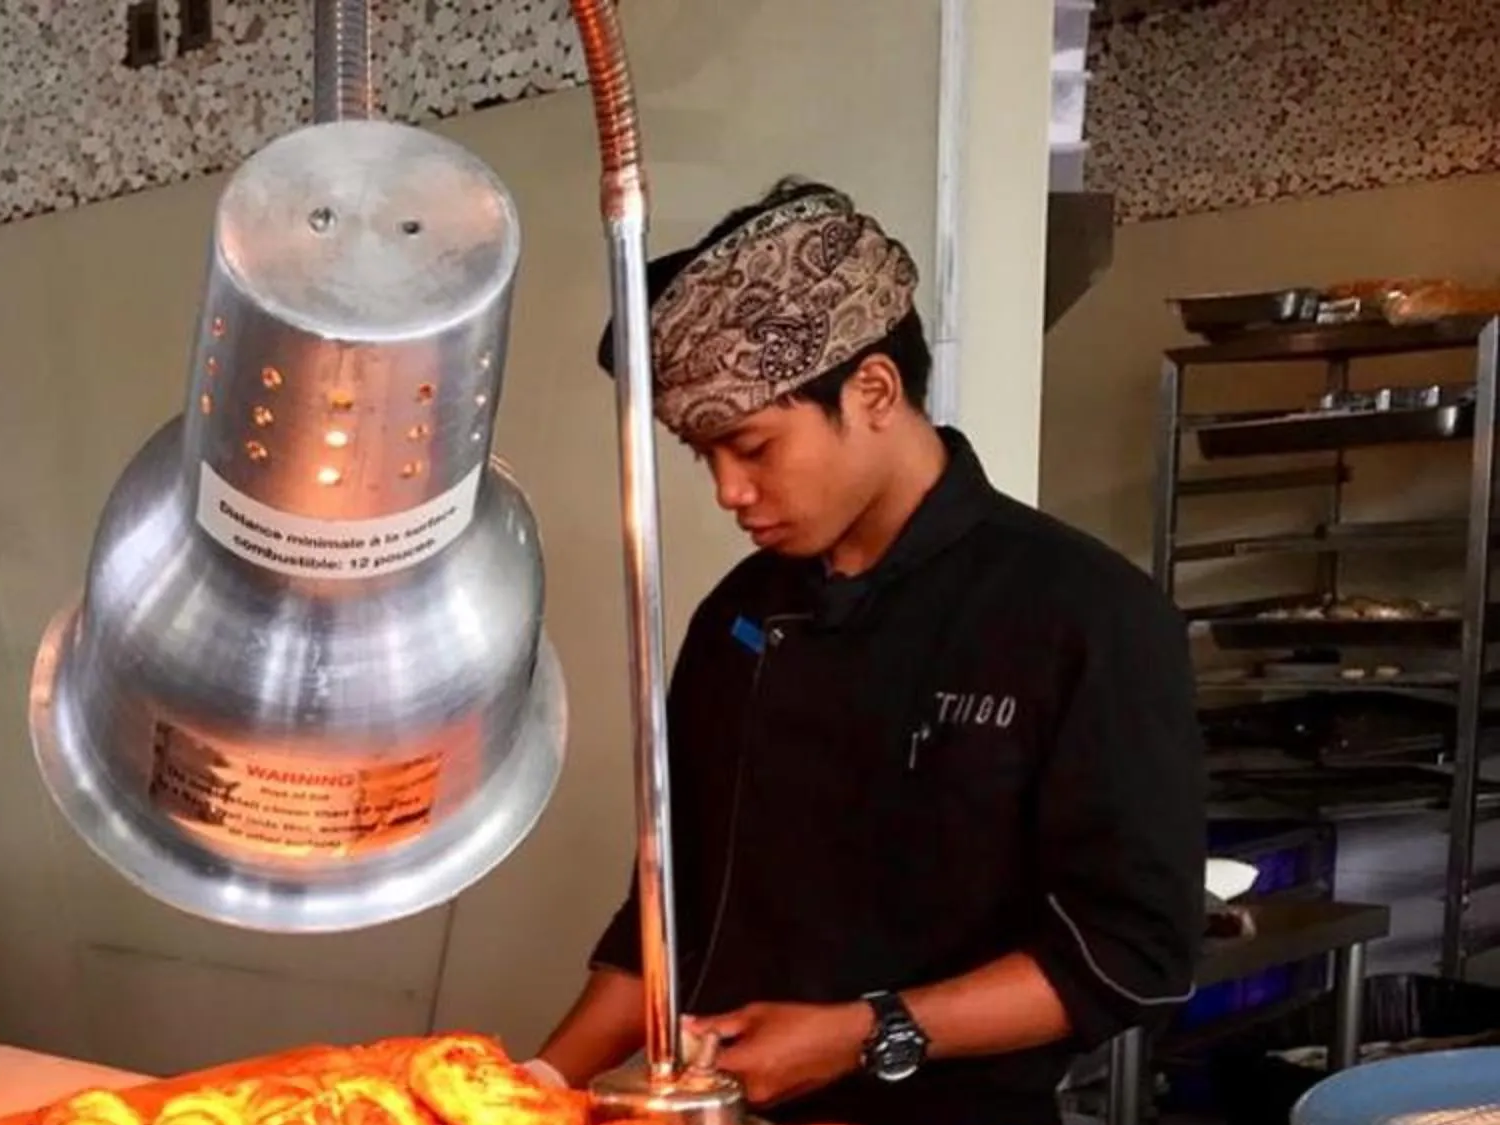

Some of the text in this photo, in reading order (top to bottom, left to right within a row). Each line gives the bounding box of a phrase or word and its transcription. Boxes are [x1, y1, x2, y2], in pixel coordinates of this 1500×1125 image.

[218, 499, 283, 541] Distance
[286, 533, 365, 550] minimale
[404, 505, 458, 540] surface
[232, 534, 343, 570] combustible:
[350, 556, 370, 570] 12
[246, 763, 355, 788] WARNING
